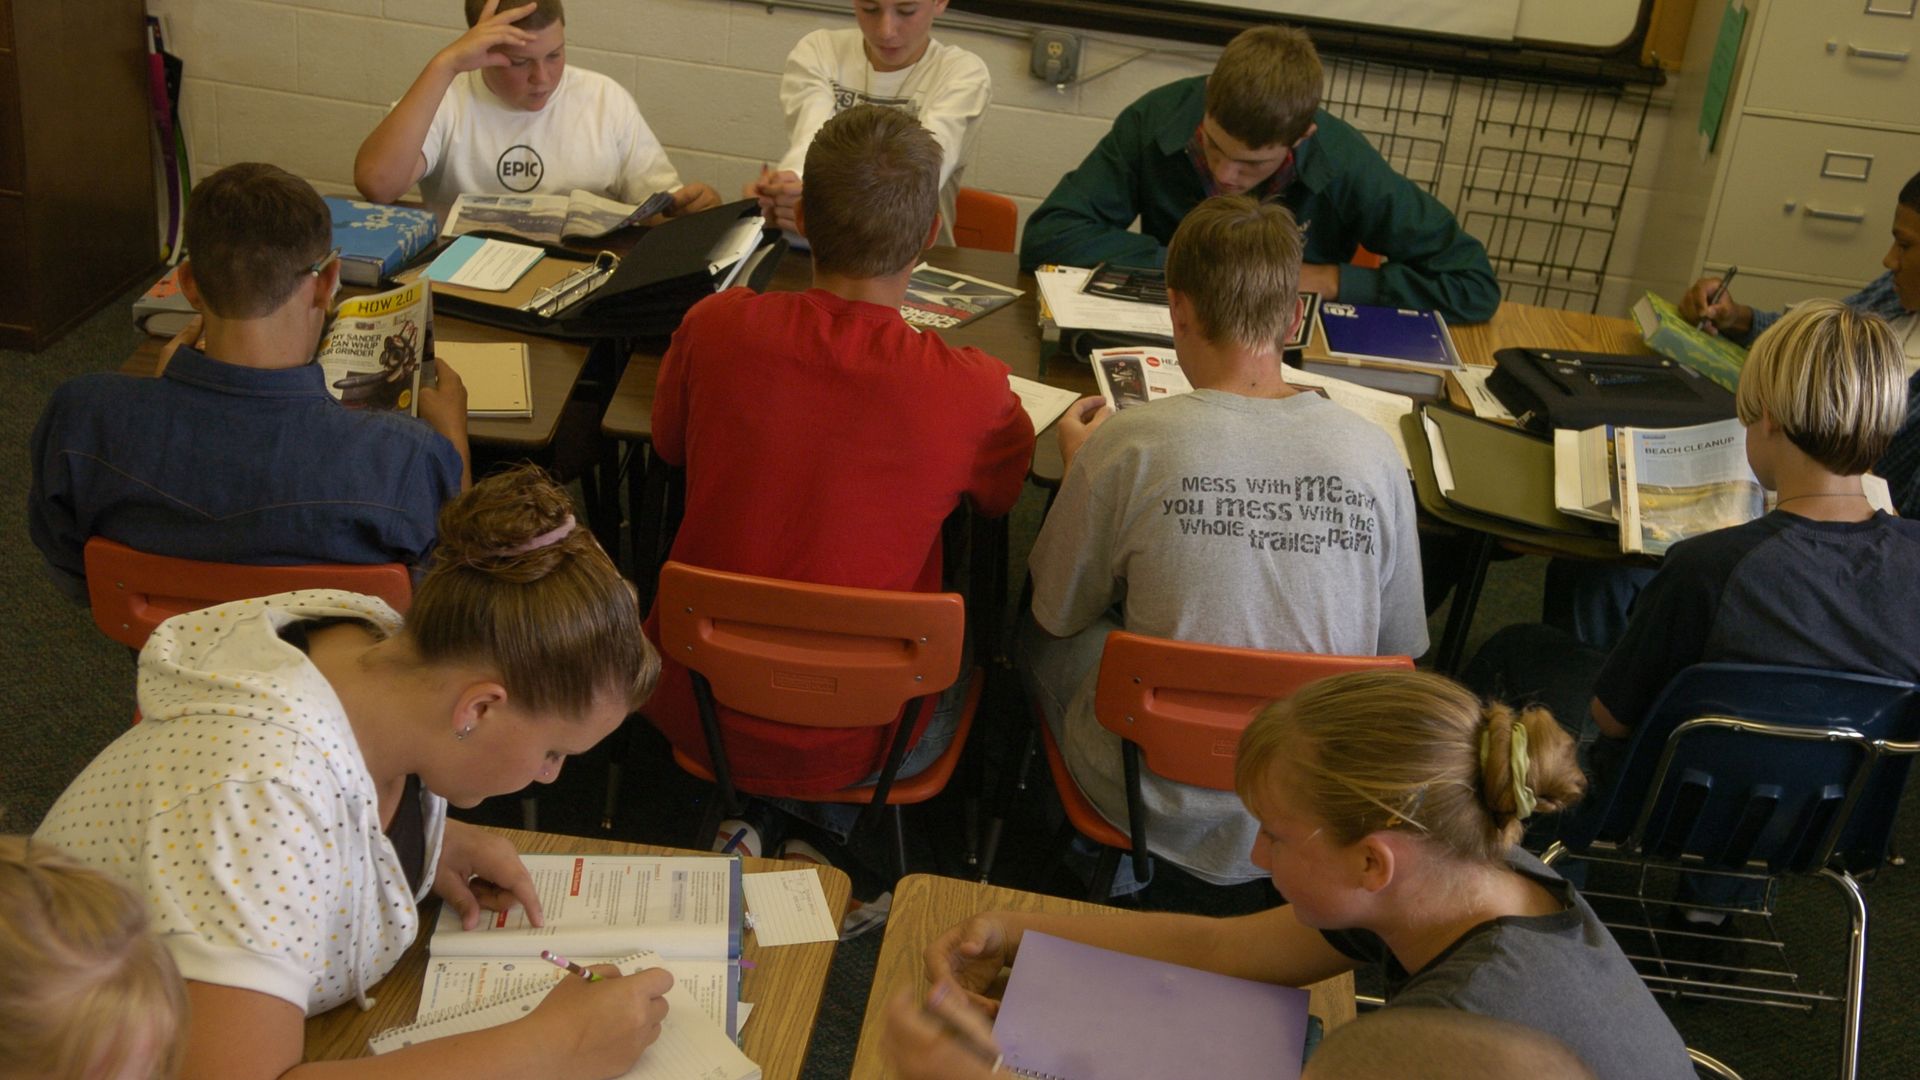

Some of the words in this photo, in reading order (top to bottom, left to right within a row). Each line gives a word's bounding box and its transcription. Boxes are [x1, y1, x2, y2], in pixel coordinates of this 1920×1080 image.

[503, 161, 538, 177] EPIC
[358, 299, 392, 313] HOW
[395, 289, 414, 306] 2.0
[331, 340, 349, 348] CAN
[346, 333, 382, 342] SANDER
[336, 347, 374, 357] GRINDER
[1645, 447, 1681, 455] BEACH
[1683, 436, 1735, 452] CLEANUP
[1295, 475, 1343, 503] me
[1162, 498, 1203, 515] you
[1216, 497, 1292, 521] mess
[1349, 513, 1374, 533] the
[1248, 529, 1326, 555] trailer
